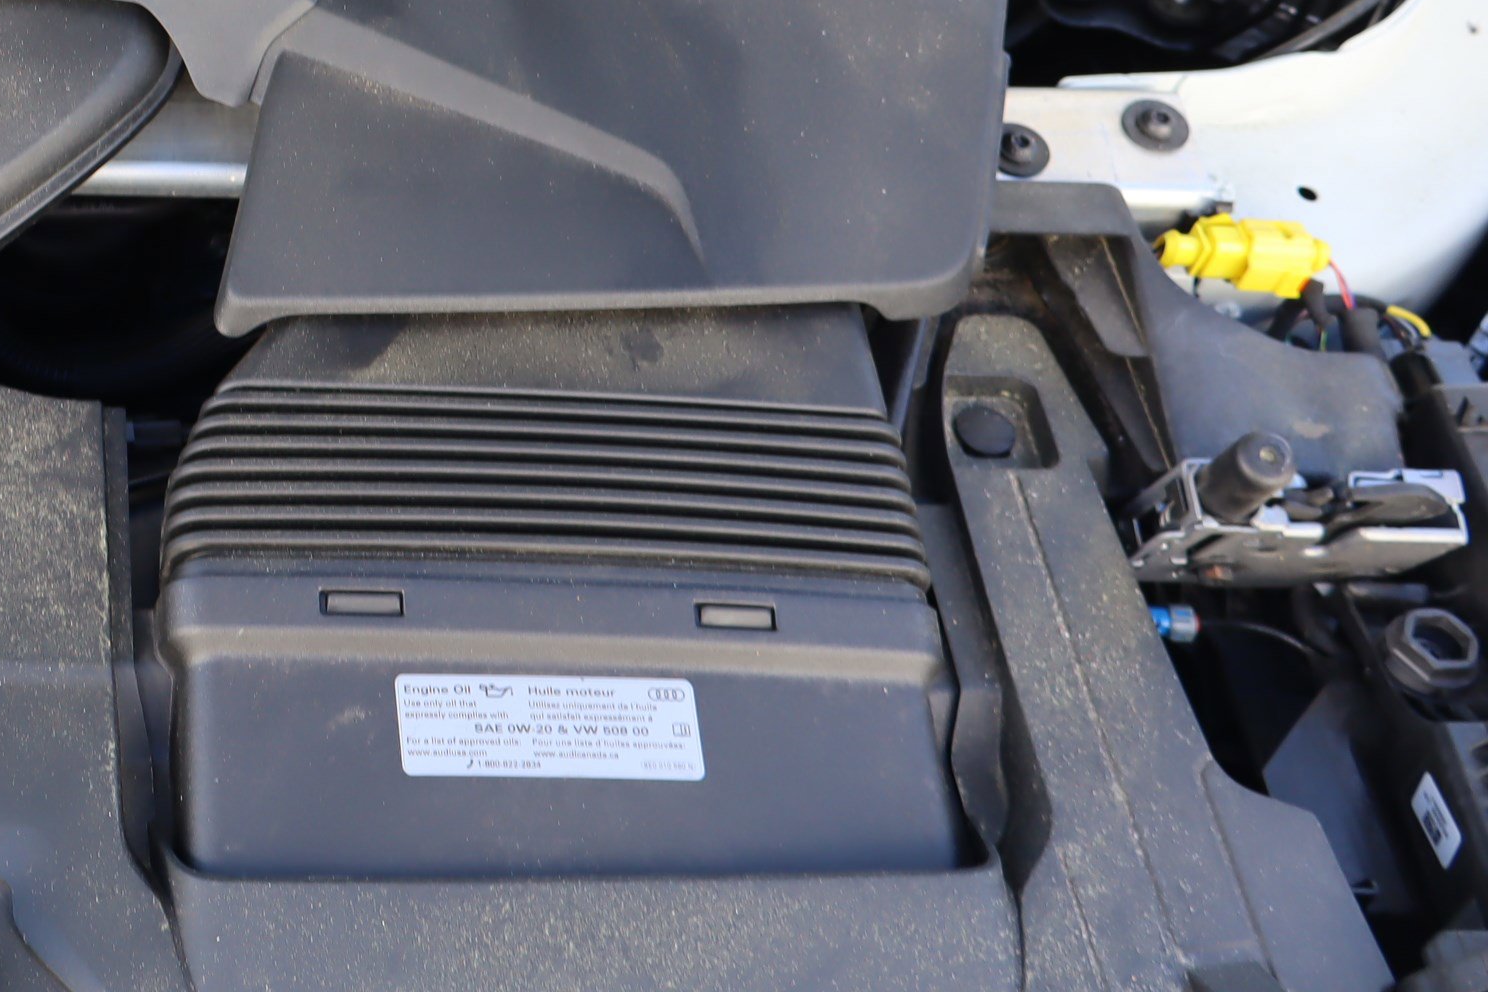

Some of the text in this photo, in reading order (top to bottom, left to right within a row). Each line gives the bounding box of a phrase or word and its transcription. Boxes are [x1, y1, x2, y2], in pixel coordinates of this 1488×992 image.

[403, 684, 472, 697] Engine Oil
[528, 685, 616, 698] Huile moteur
[403, 699, 478, 709] Use only oil that
[528, 700, 560, 708] Utilisez
[562, 701, 616, 711] uniquement
[618, 702, 628, 710] de
[404, 711, 509, 720] expressly complies with
[530, 712, 544, 721] qui
[546, 712, 582, 721] satisfait
[474, 723, 650, 736] SAE 0W-20 & VW 508 00
[406, 737, 422, 745] For
[432, 737, 445, 745] list
[446, 737, 456, 745] of
[458, 737, 500, 748] approved
[532, 739, 554, 747] Pour
[574, 739, 593, 747] liste
[407, 748, 488, 756] www.audiusa.com
[534, 750, 620, 759] www.audicanada.ca
